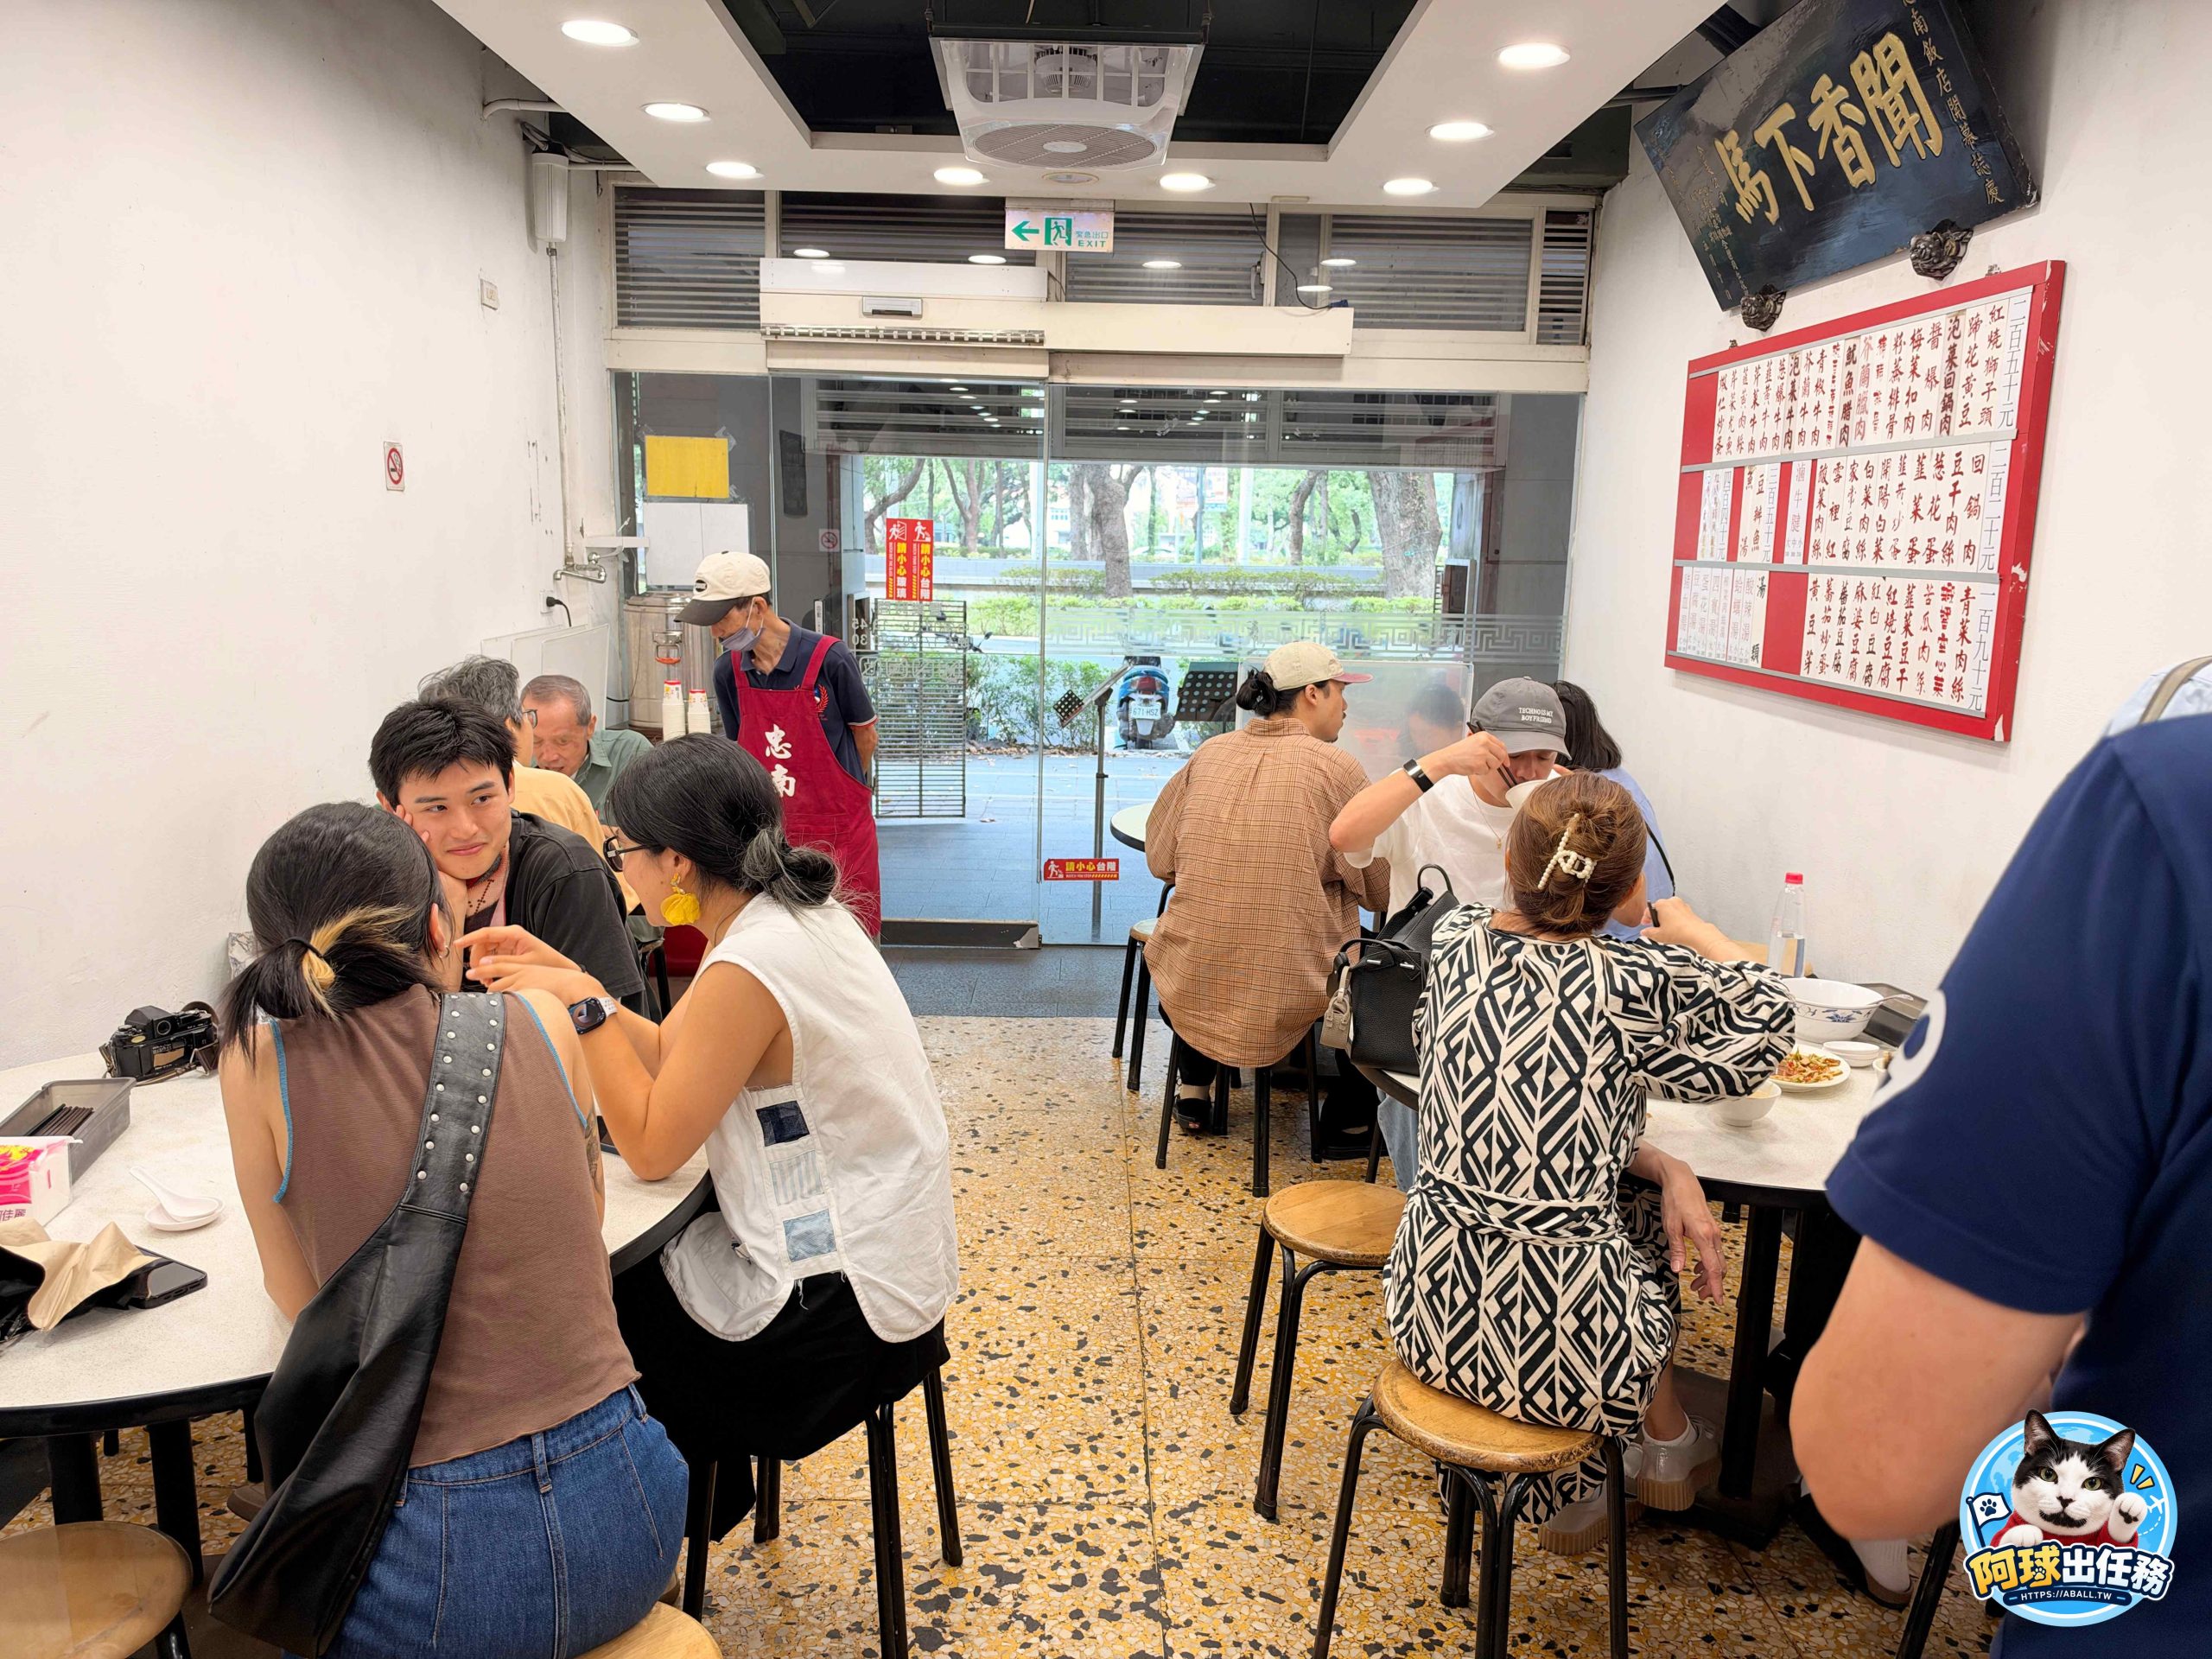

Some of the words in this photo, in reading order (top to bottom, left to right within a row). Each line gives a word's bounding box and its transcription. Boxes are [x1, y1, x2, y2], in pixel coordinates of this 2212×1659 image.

[1904, 0, 2005, 204] 南飯店開幕誌慶
[1077, 239, 1107, 248] EXIT
[1977, 305, 2005, 427] 紅燒獅子頭
[1998, 299, 2026, 429] 二百五十元
[1855, 460, 1874, 562] 白菜肉絲
[1963, 454, 1985, 566] 回鍋肉
[1980, 448, 2007, 571] 二百二十元
[1877, 585, 1898, 689] 紅燒豆腐
[1951, 586, 1976, 702] 青菜肉絲
[1968, 592, 1996, 711] 一百九十元
[765, 724, 796, 798] 忠南
[1521, 715, 1552, 723] BOYFRIEND
